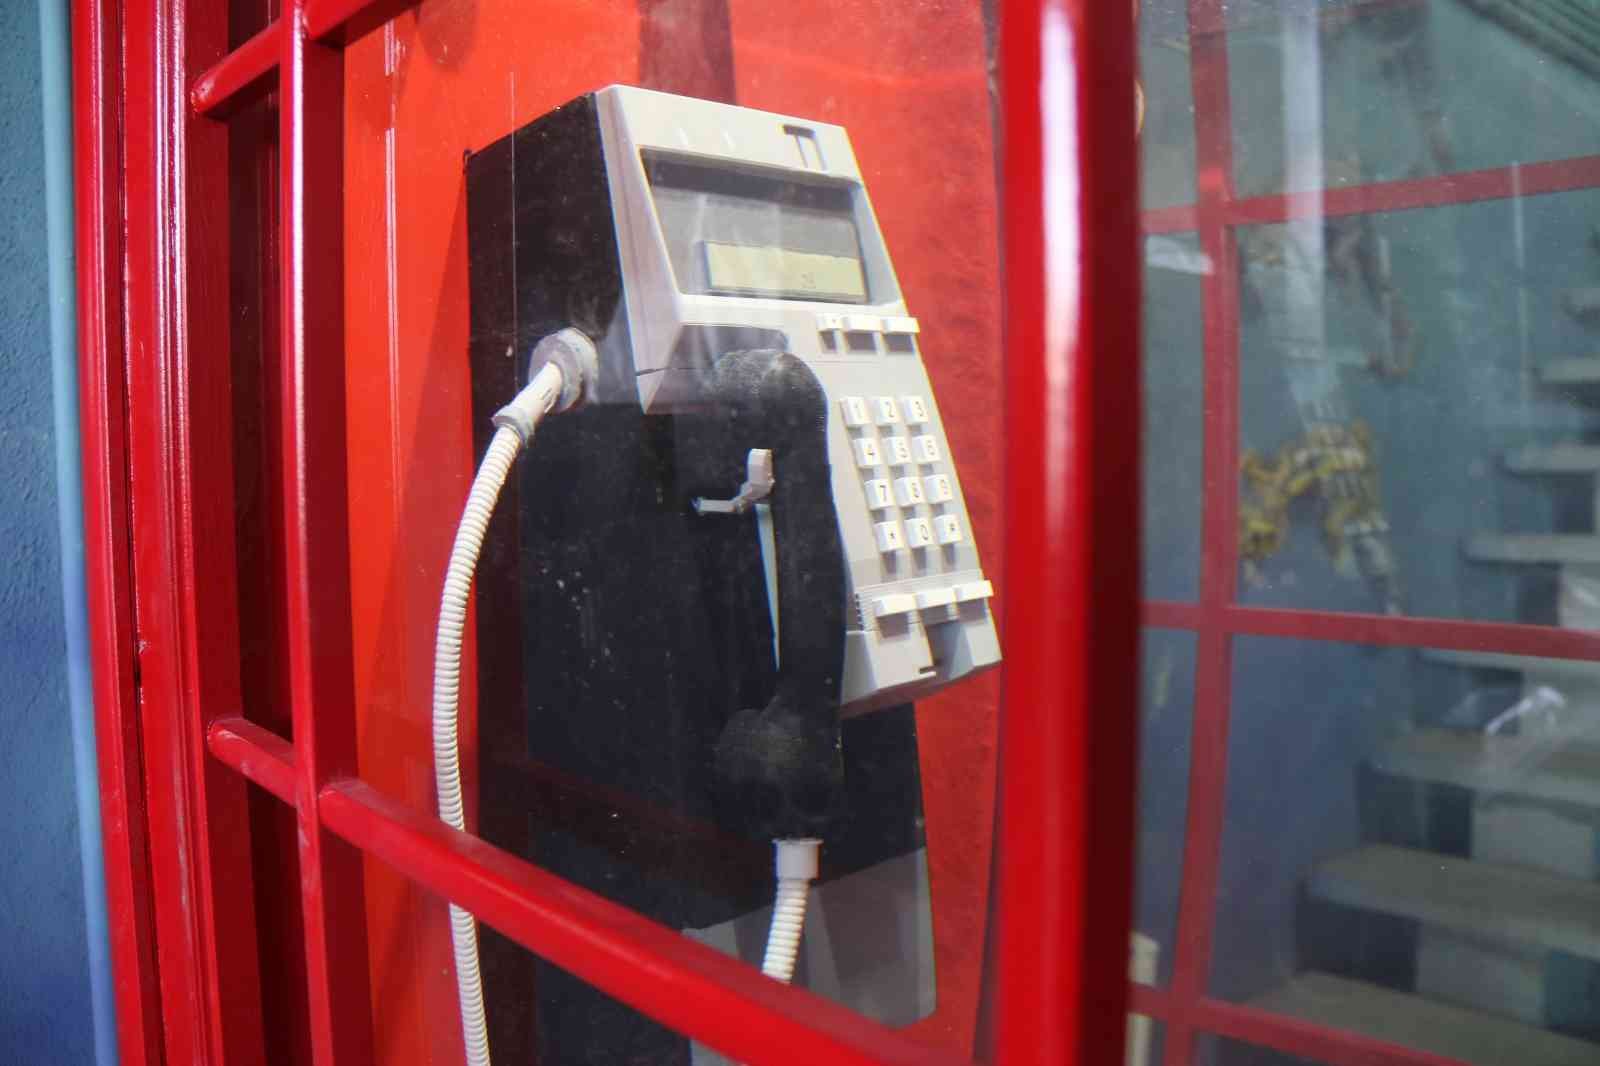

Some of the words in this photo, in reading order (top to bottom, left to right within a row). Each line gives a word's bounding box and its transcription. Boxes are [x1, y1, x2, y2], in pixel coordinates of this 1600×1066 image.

[884, 401, 895, 418] 2
[914, 401, 925, 417] 3
[879, 483, 888, 502] 7
[919, 524, 929, 542] 0
